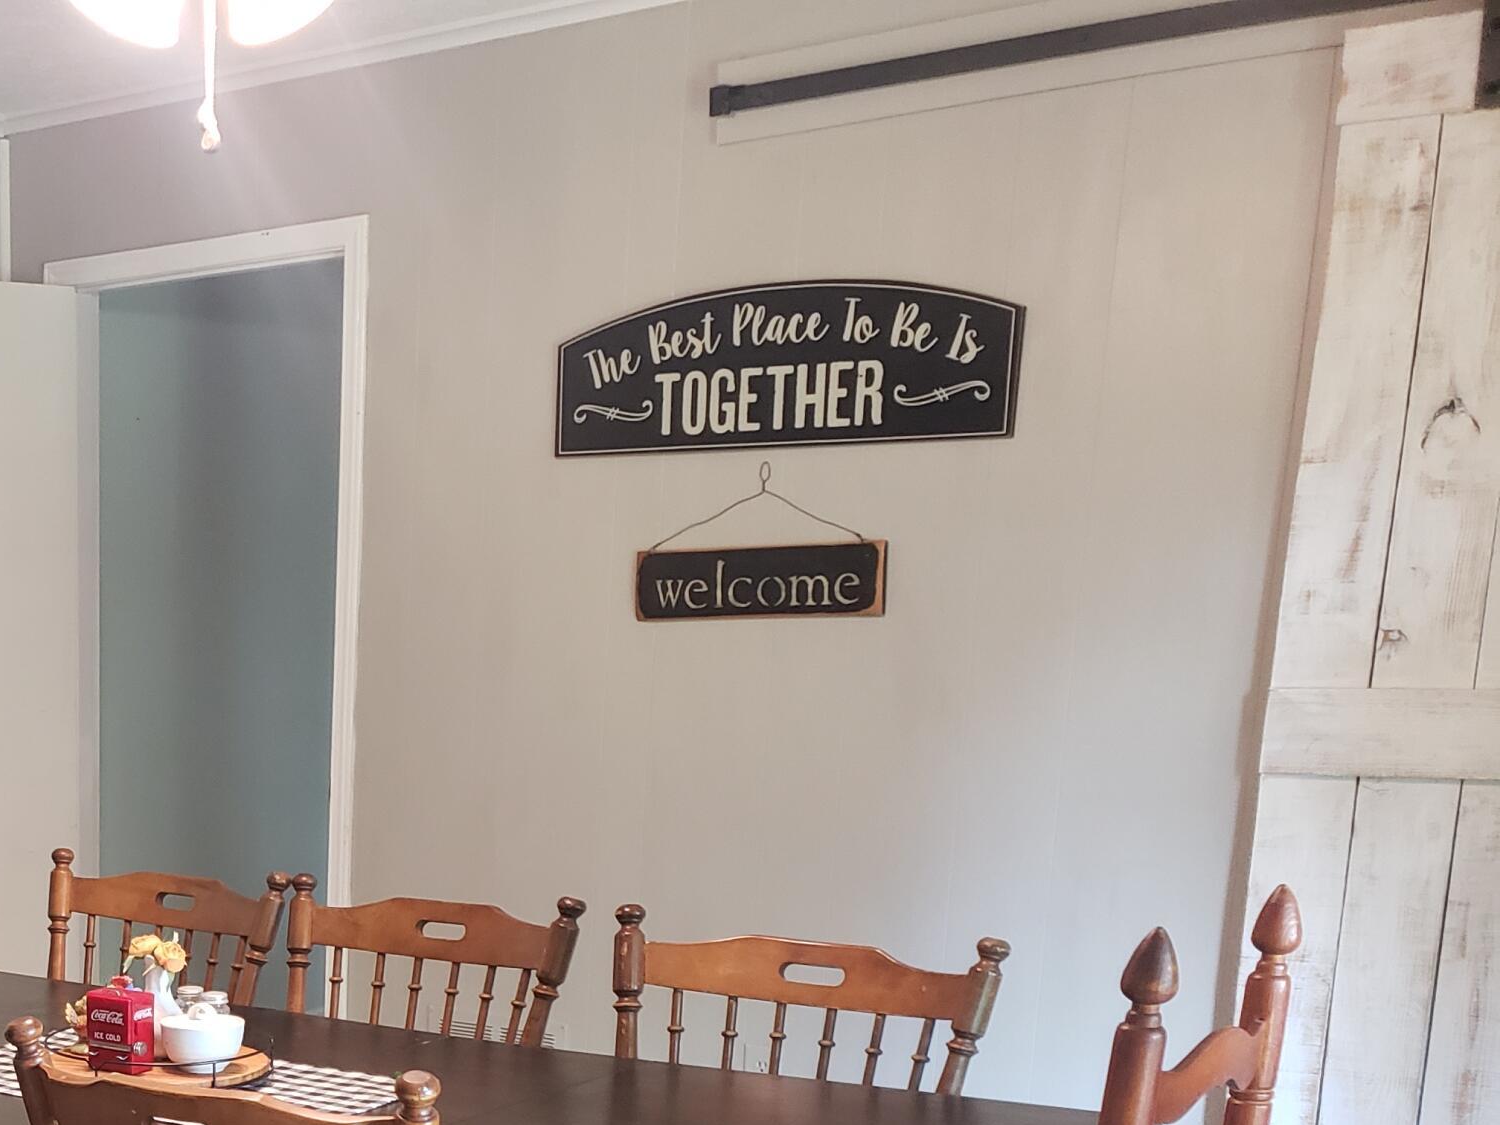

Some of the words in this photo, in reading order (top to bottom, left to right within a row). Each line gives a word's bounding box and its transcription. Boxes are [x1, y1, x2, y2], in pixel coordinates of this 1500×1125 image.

[583, 348, 642, 390] The
[647, 311, 722, 365] Best
[731, 302, 830, 347] Place
[844, 297, 880, 344] To
[889, 301, 940, 354] Be
[945, 313, 986, 364] Is
[654, 360, 885, 436] TOGETHER
[655, 560, 861, 609] welcome
[94, 1032, 104, 1040] ICE
[105, 1033, 121, 1042] COLD
